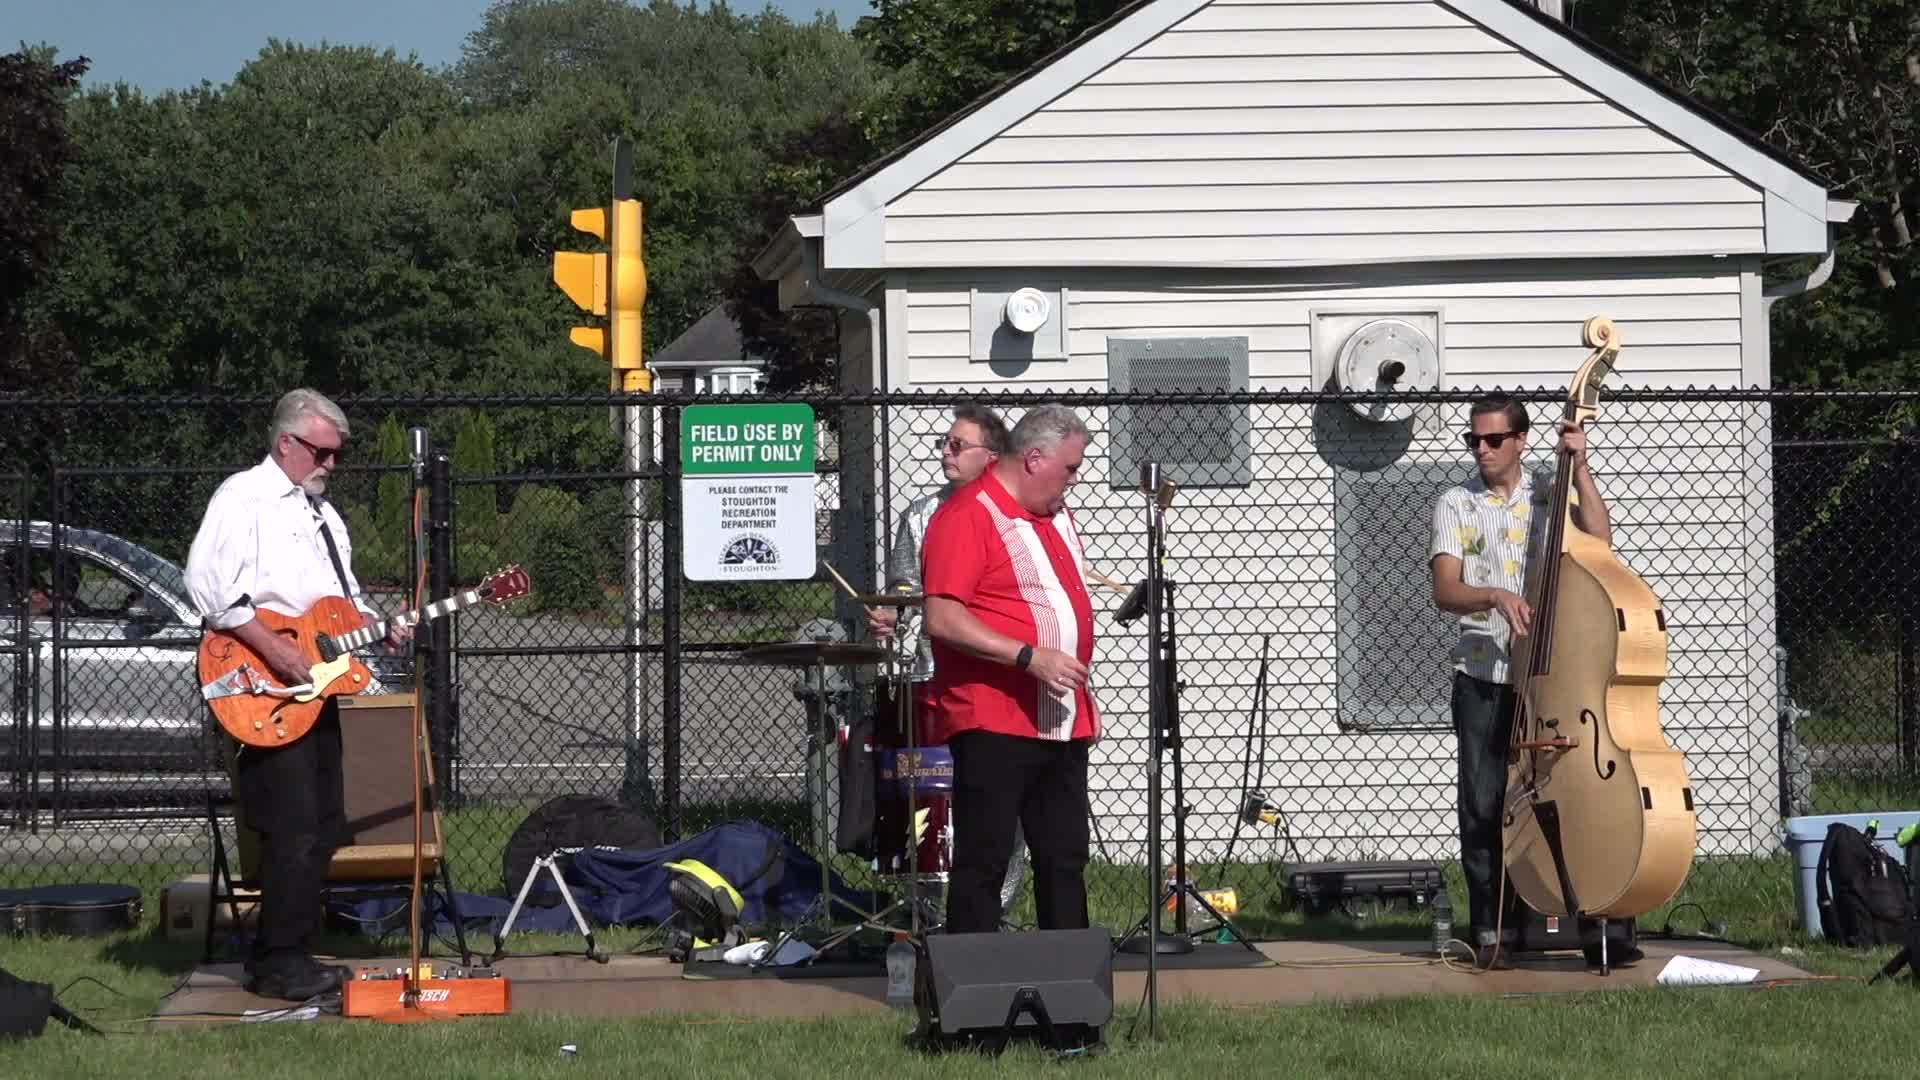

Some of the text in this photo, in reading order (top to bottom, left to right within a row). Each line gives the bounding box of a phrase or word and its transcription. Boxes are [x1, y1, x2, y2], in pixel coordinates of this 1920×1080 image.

[691, 424, 804, 442] FIELD USE BY
[692, 445, 803, 462] PERMIT ONLY
[738, 486, 772, 494] CONTACT
[774, 485, 788, 493] THE
[721, 497, 777, 506] STOUGHTON
[721, 508, 777, 517] RECREATION
[721, 520, 777, 529] DEPARTMENT
[723, 565, 777, 573] STOUGHTON
[398, 989, 450, 1002] TSCH
